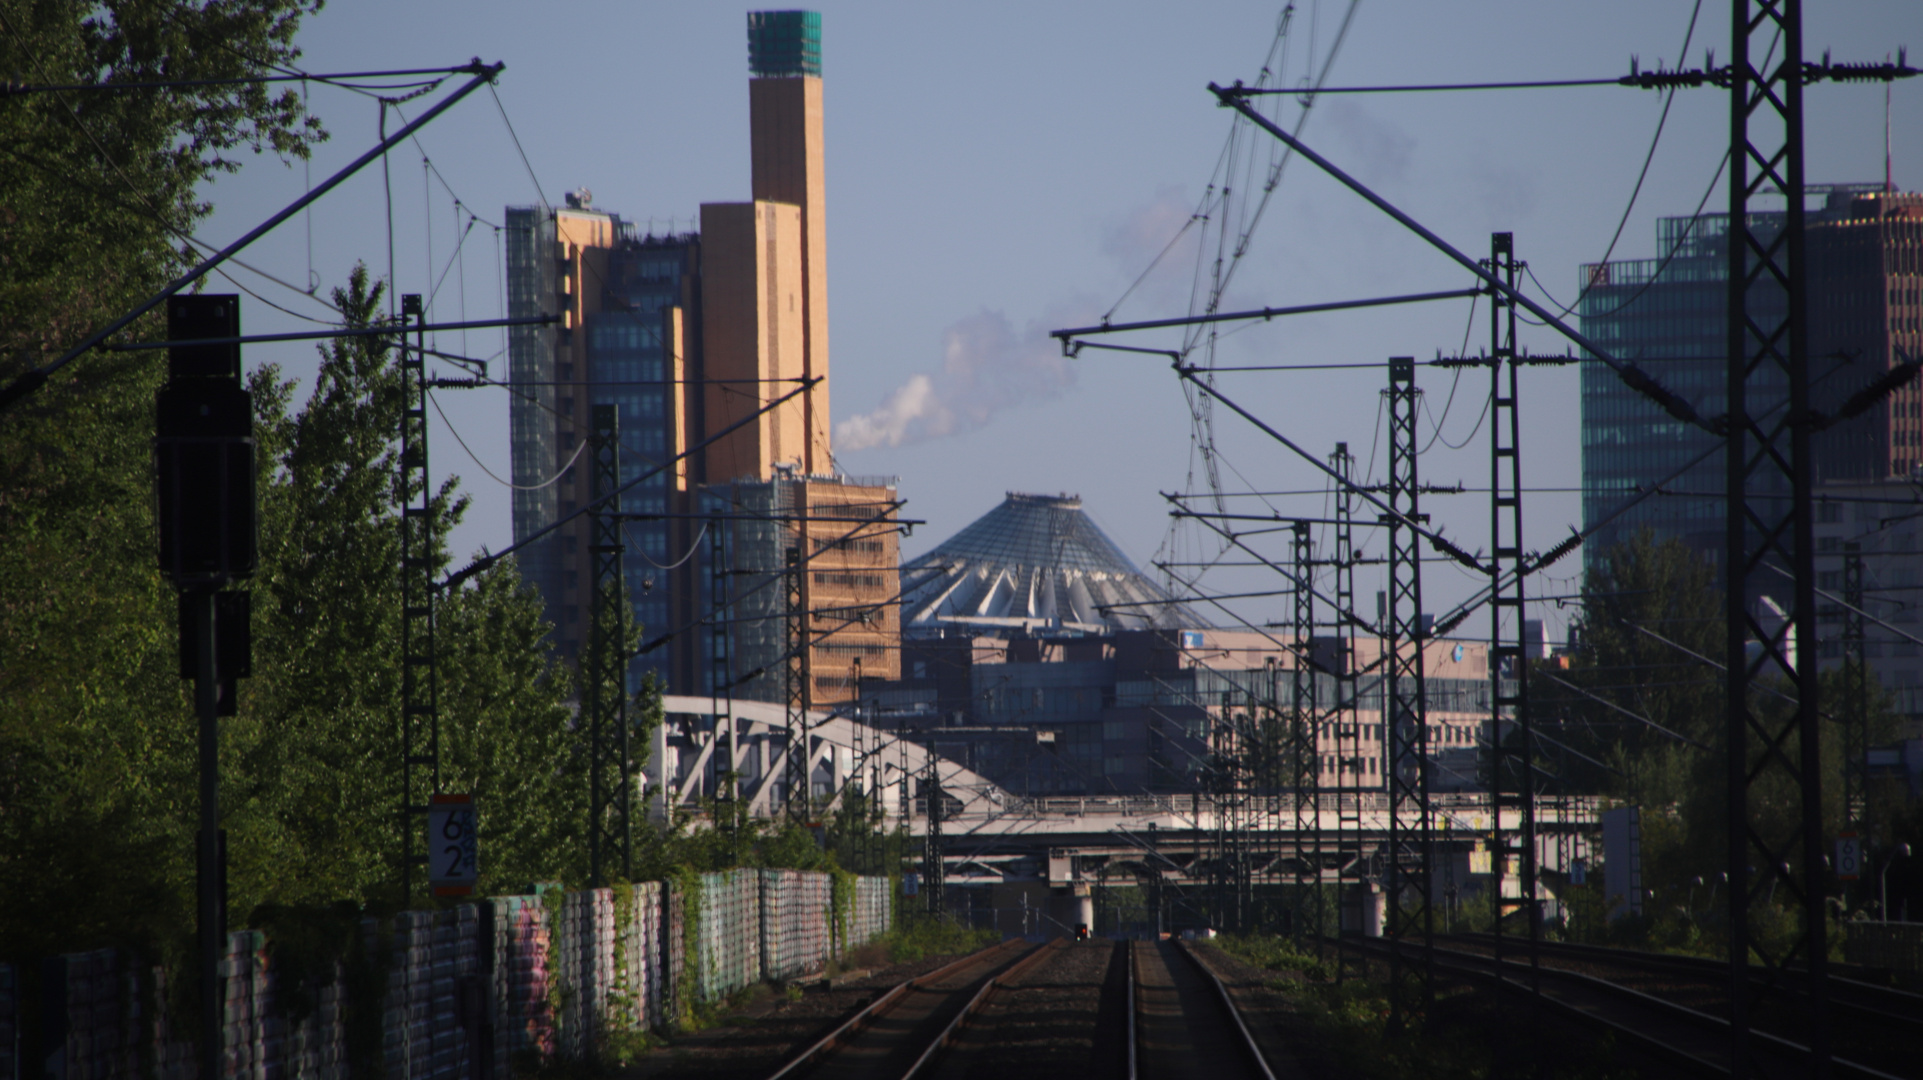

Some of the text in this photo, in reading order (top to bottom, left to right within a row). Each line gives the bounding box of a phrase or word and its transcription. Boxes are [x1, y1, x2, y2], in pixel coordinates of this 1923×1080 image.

[443, 810, 462, 840] 6
[1843, 840, 1854, 855] 6
[444, 845, 462, 877] 2
[1843, 856, 1854, 871] 0
